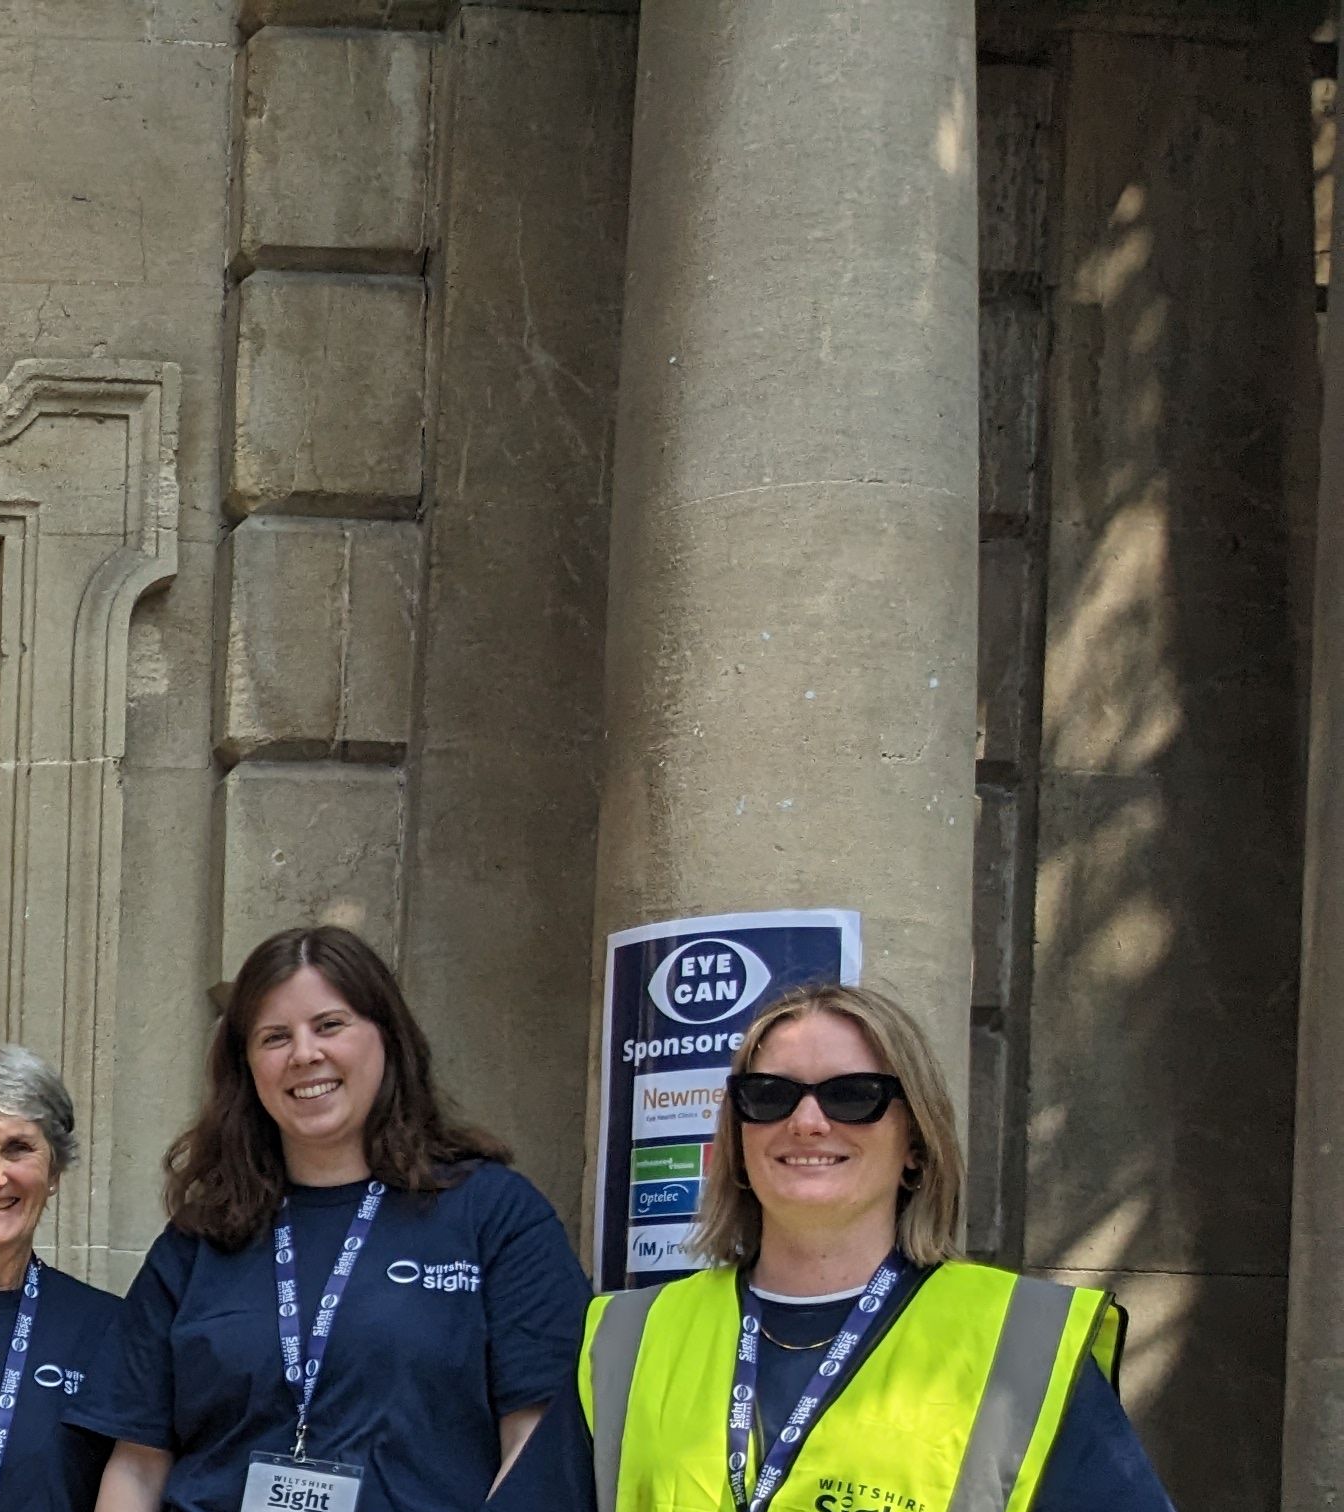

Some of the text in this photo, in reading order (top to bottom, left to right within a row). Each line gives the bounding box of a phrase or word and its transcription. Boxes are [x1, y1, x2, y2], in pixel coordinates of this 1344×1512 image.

[681, 954, 732, 977] EYE
[674, 980, 737, 1004] CAN
[622, 1032, 745, 1067] Sponsore
[643, 1087, 726, 1110] Newme
[639, 1191, 679, 1206] Optelec
[639, 1242, 656, 1257] IM
[333, 1251, 353, 1276] Sight
[422, 1272, 480, 1292] sight
[870, 1267, 897, 1297] Sight
[312, 1309, 330, 1337] Sight
[739, 1332, 754, 1362] Sight
[831, 1331, 858, 1361] Sight
[730, 1401, 746, 1429] Sight
[274, 1475, 334, 1491] WILTSHIRE
[267, 1483, 330, 1512] Sight
